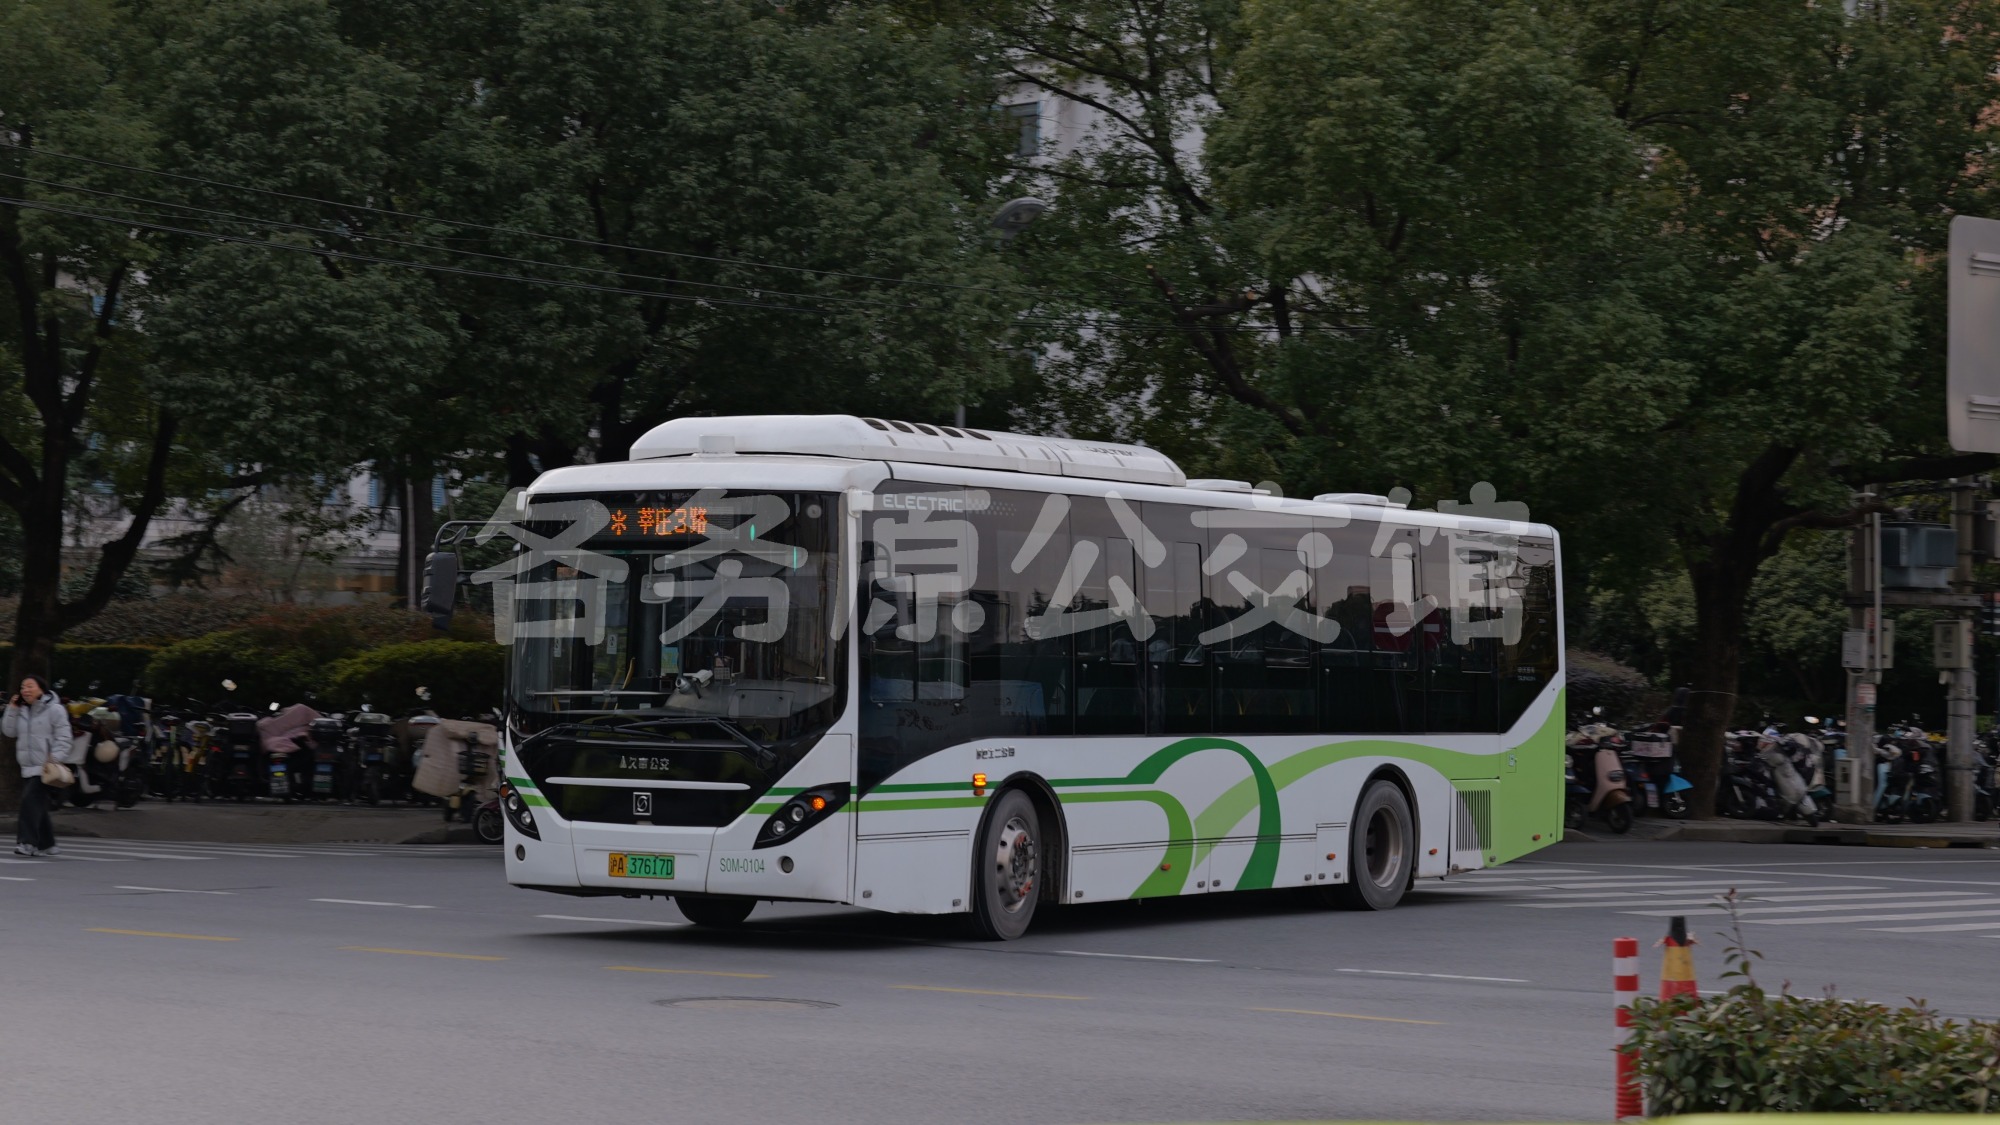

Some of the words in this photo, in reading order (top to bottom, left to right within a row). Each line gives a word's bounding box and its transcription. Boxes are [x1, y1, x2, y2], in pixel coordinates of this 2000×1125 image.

[883, 493, 963, 513] ELECTRIC
[637, 506, 708, 535] 莘庄3路
